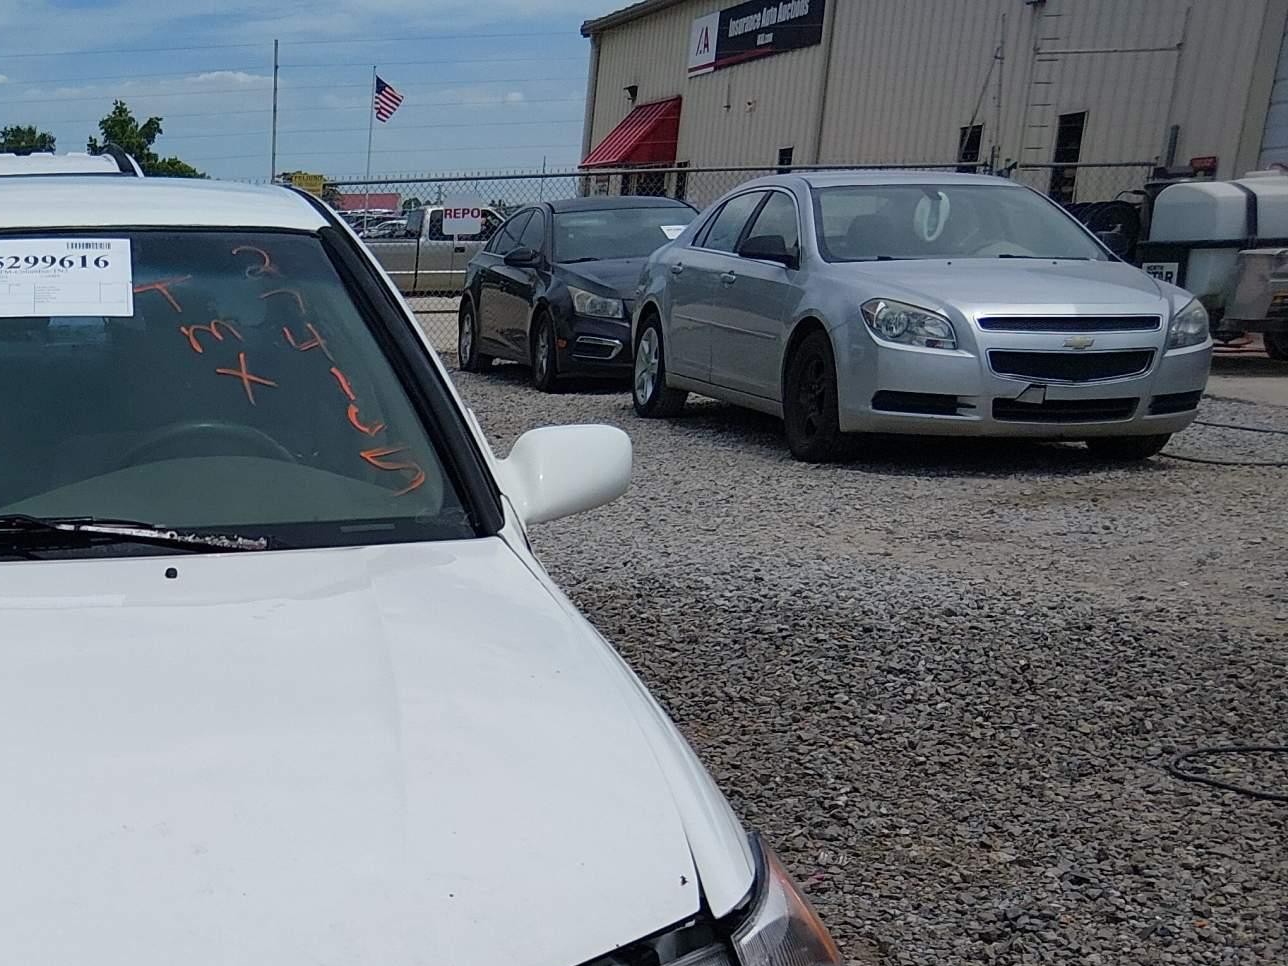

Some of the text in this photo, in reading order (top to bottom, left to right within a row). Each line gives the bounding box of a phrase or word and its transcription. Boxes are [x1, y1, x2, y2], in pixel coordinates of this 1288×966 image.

[728, 0, 809, 37] Insurance Auto Auctions
[444, 207, 481, 219] REPO
